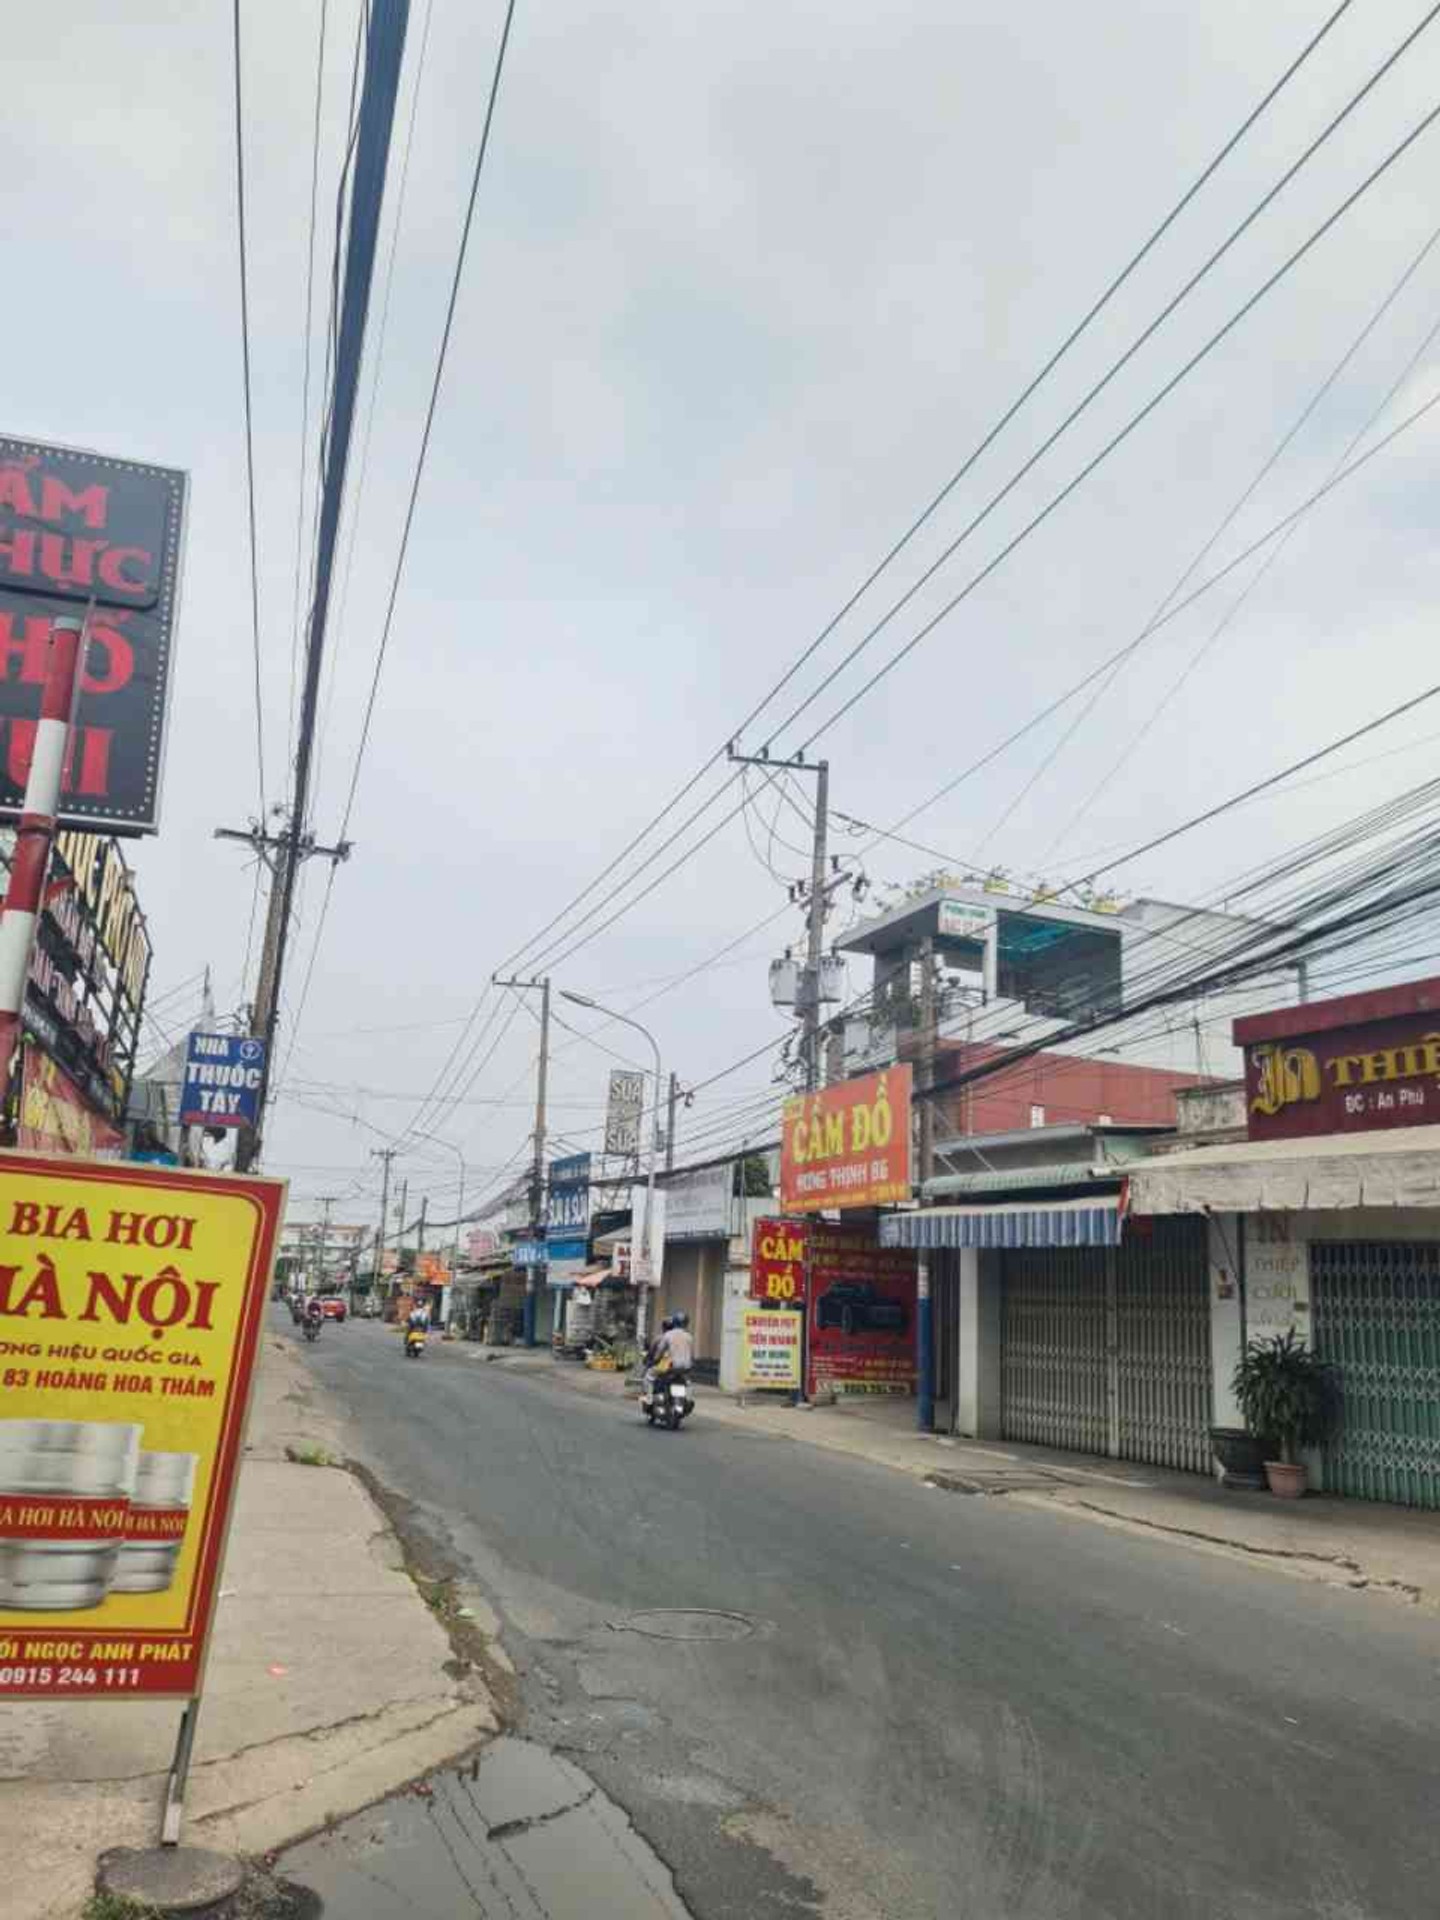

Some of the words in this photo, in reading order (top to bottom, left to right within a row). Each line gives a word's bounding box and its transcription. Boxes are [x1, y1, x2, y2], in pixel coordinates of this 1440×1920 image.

[8, 1201, 91, 1241] BIA
[105, 1210, 196, 1250] HƠI
[79, 1266, 221, 1341] NỘI
[48, 1344, 97, 1362] HIỆU
[102, 1345, 163, 1364] QUỐC
[168, 1353, 202, 1368] GIA
[3, 1368, 30, 1388] 83
[36, 1367, 106, 1391] HOÀNG
[113, 1374, 153, 1394] HOA
[24, 1640, 84, 1663] NGỌC
[89, 1643, 133, 1661] ANH
[0, 1667, 52, 1685] 0915
[58, 1668, 97, 1685] 244
[104, 1668, 140, 1687] 111
